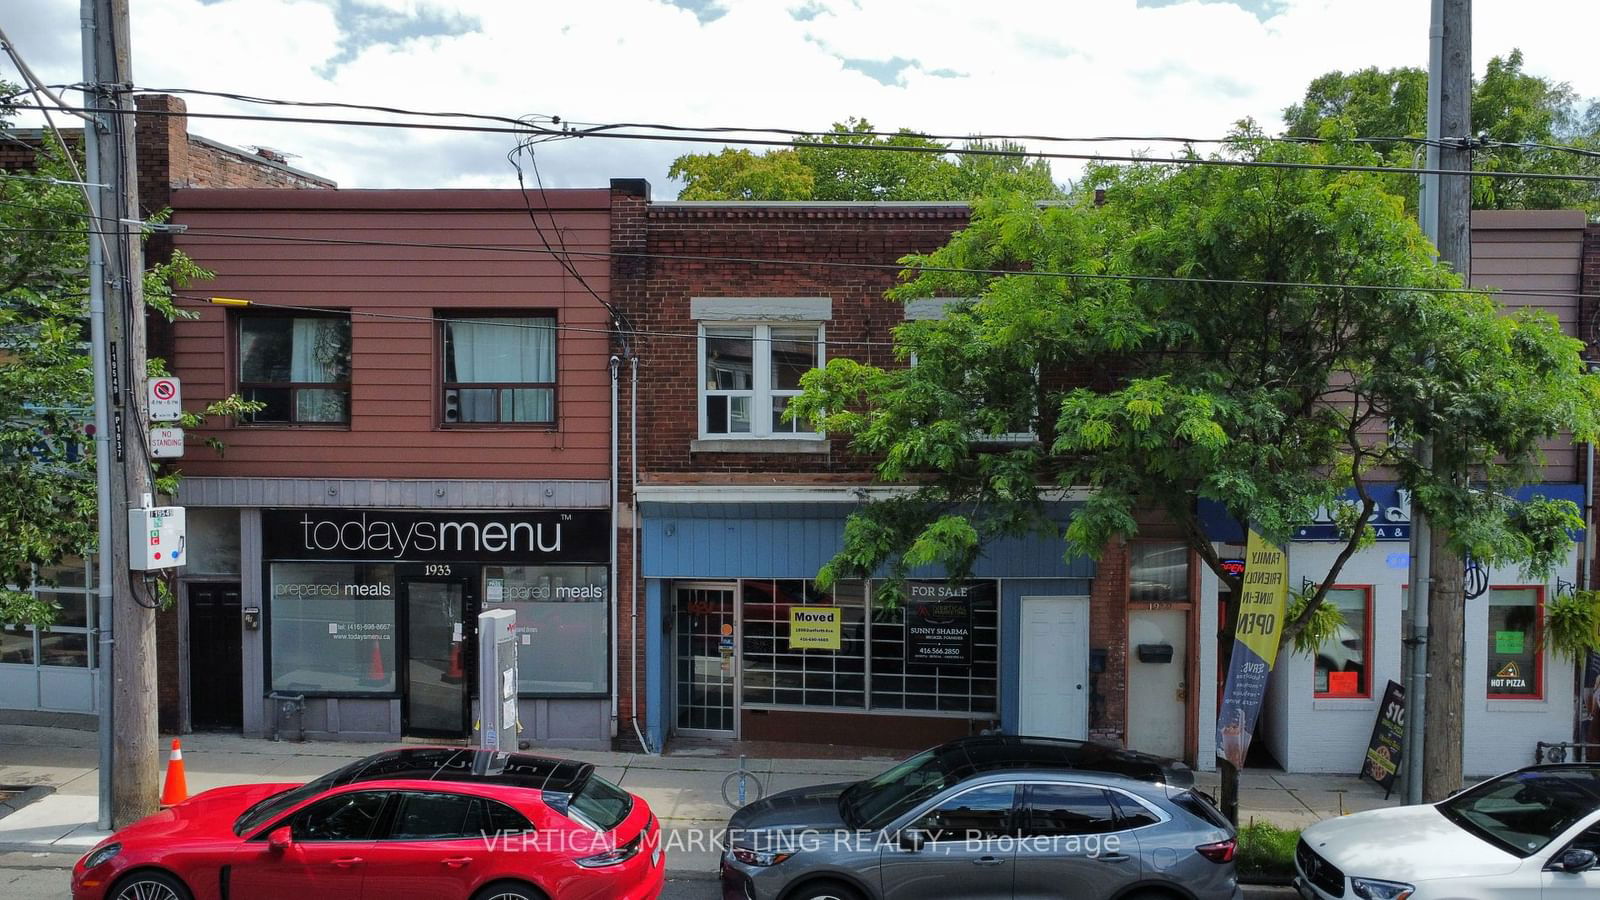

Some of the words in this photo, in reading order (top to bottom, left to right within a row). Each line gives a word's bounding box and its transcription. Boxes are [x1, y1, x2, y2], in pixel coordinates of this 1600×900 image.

[300, 513, 561, 558] todaysmenu
[425, 565, 451, 576] 1933
[275, 582, 339, 600] prepared
[344, 582, 391, 596] meals
[556, 584, 603, 598] meals
[912, 586, 936, 596] FOR
[938, 587, 968, 597] SALE
[795, 612, 834, 622] Moved
